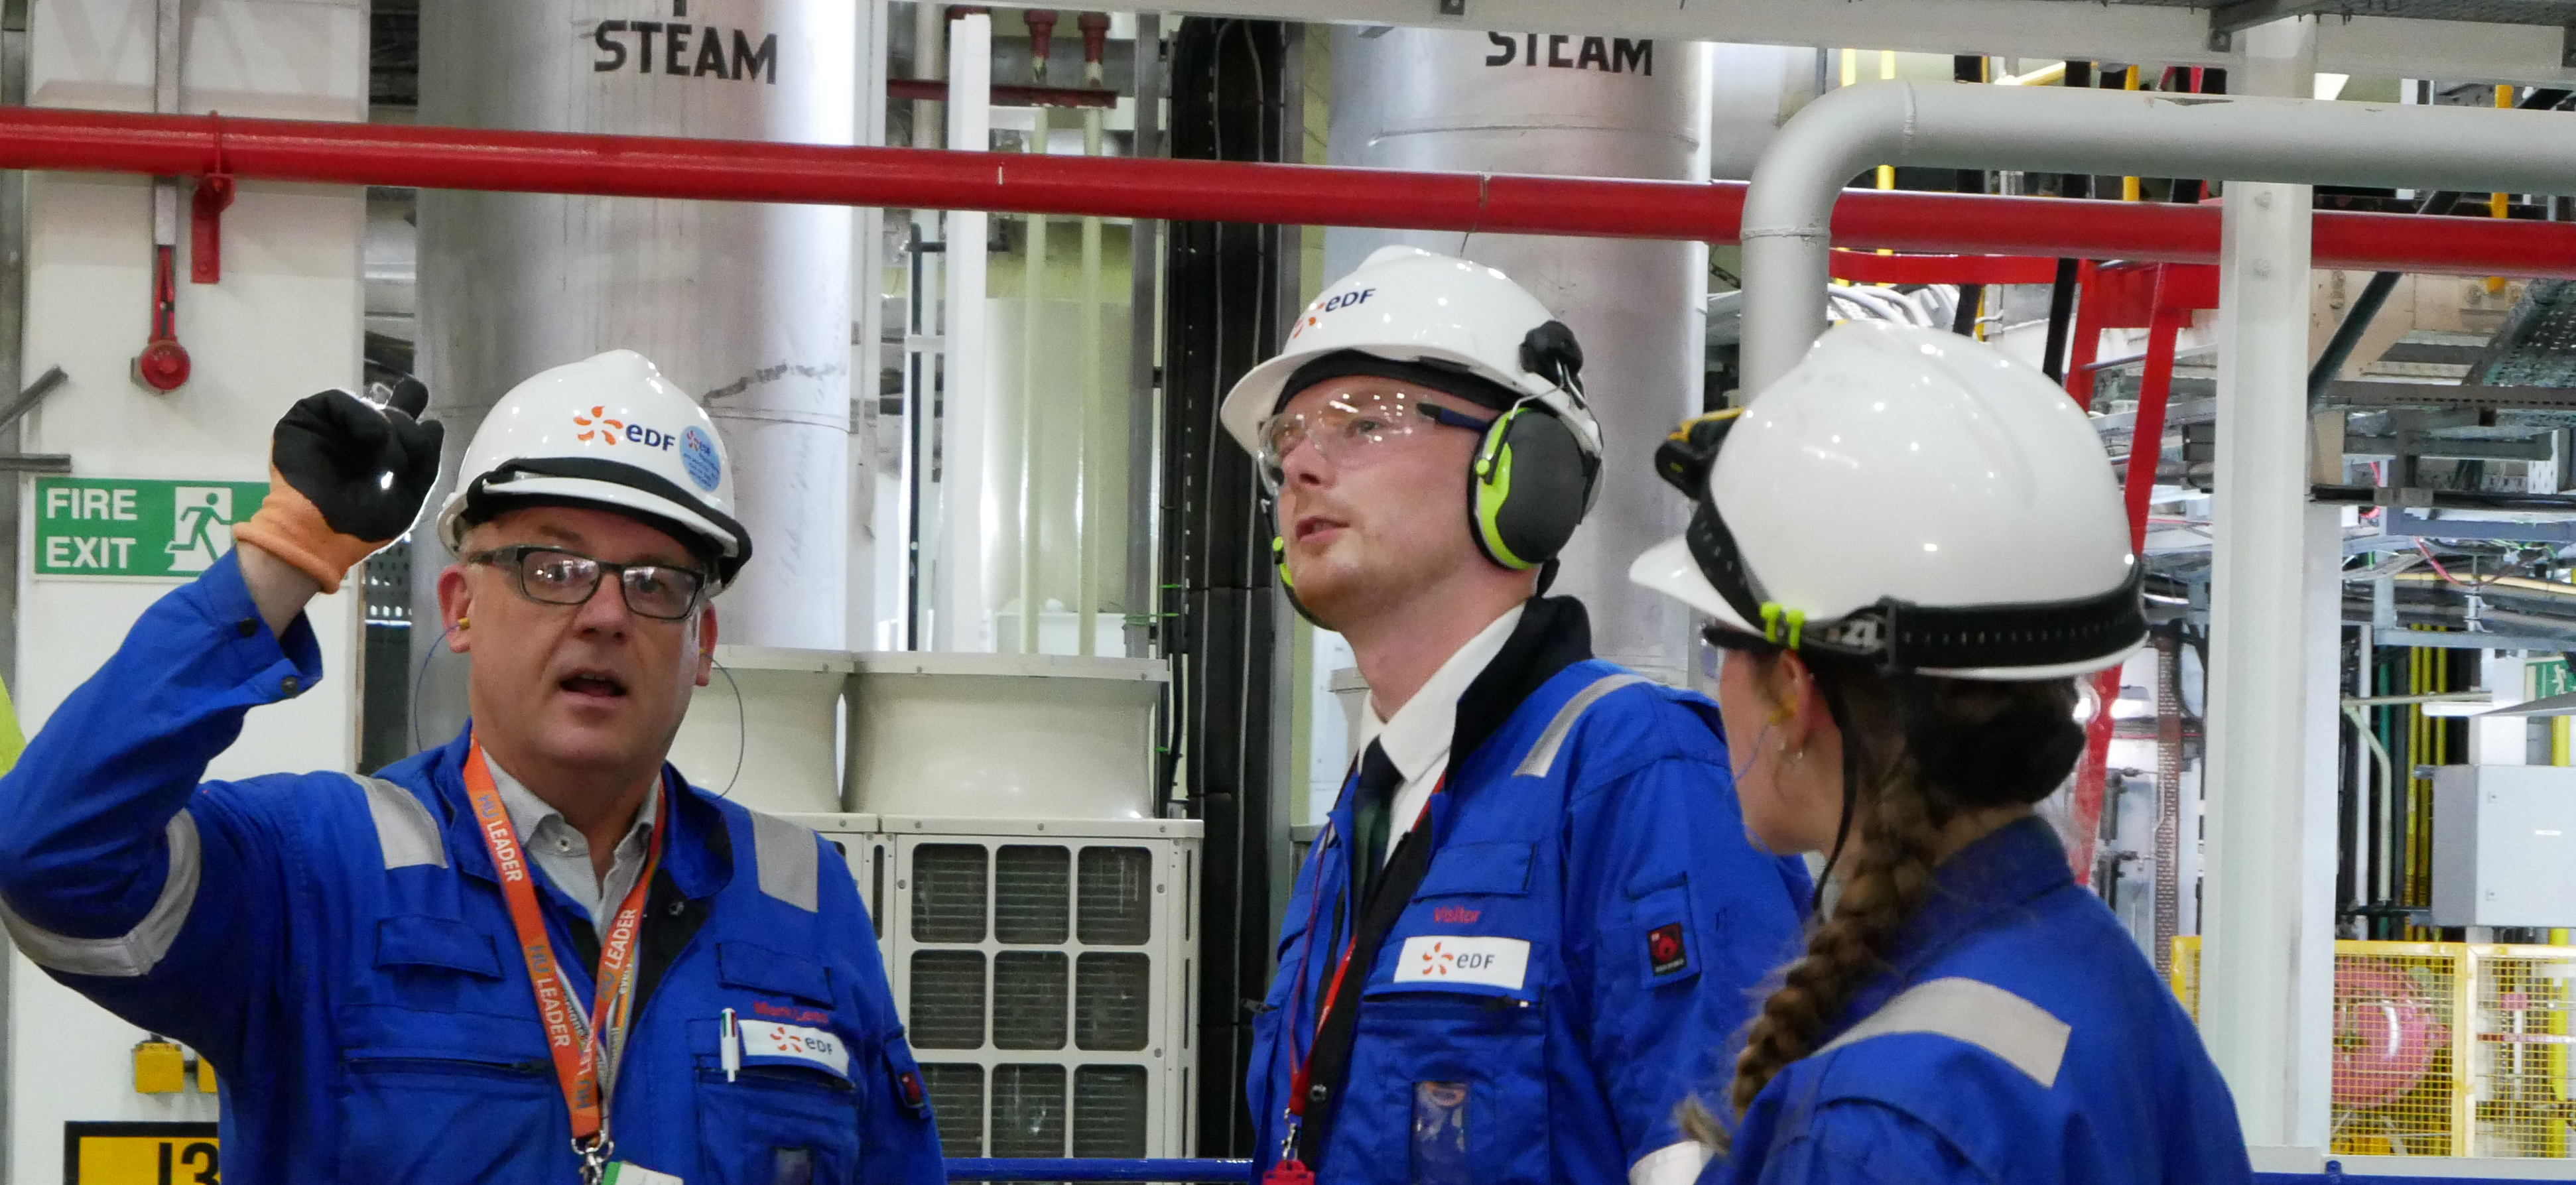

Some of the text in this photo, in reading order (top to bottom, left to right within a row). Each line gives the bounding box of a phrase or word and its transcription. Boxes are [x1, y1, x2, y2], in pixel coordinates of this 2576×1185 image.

[594, 19, 777, 84] STEAM
[1486, 31, 1653, 76] STEAM
[47, 487, 137, 521] FIRE
[46, 536, 137, 569] EXIT
[487, 820, 523, 882] LEADER
[604, 908, 638, 969] LEADER
[536, 978, 571, 1047] LEADER
